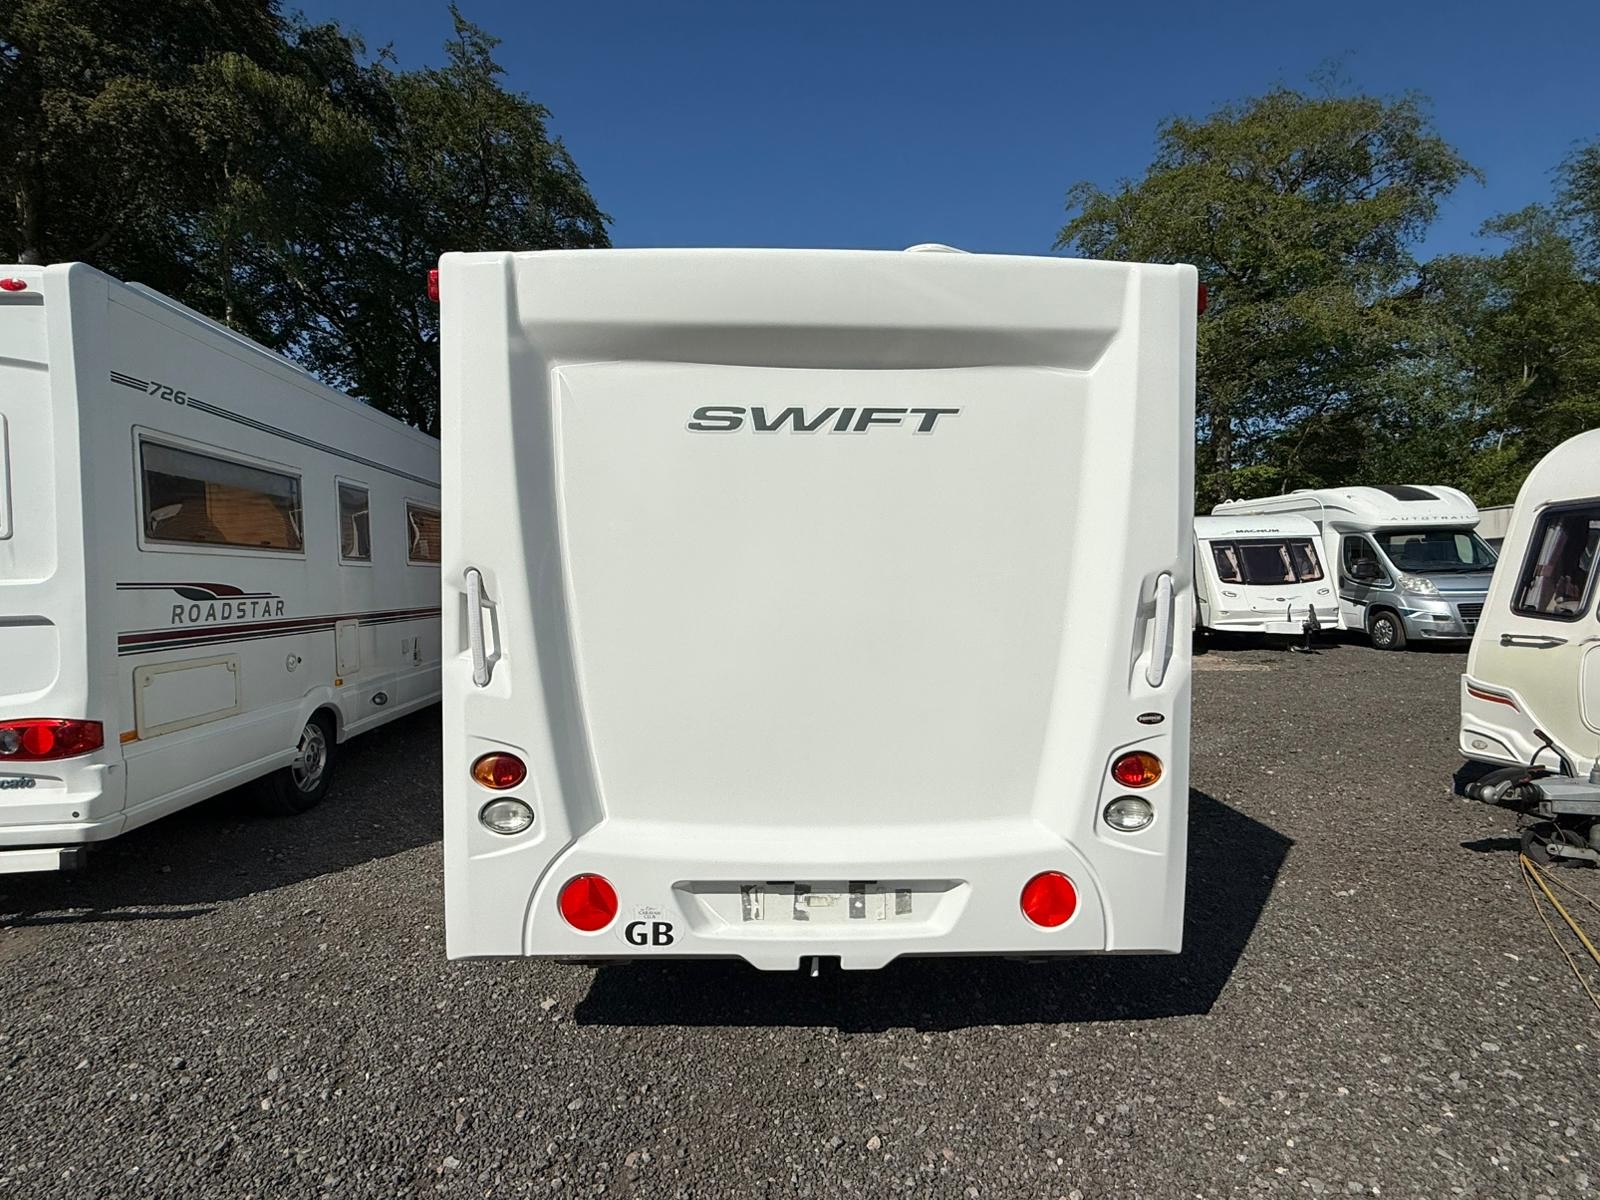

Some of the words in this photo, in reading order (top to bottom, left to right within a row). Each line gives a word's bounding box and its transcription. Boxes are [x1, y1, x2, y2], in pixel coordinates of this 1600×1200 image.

[148, 381, 187, 406] 726
[687, 405, 961, 434] SWIFT
[171, 600, 285, 625] ROADSTAR
[624, 920, 675, 947] GB
